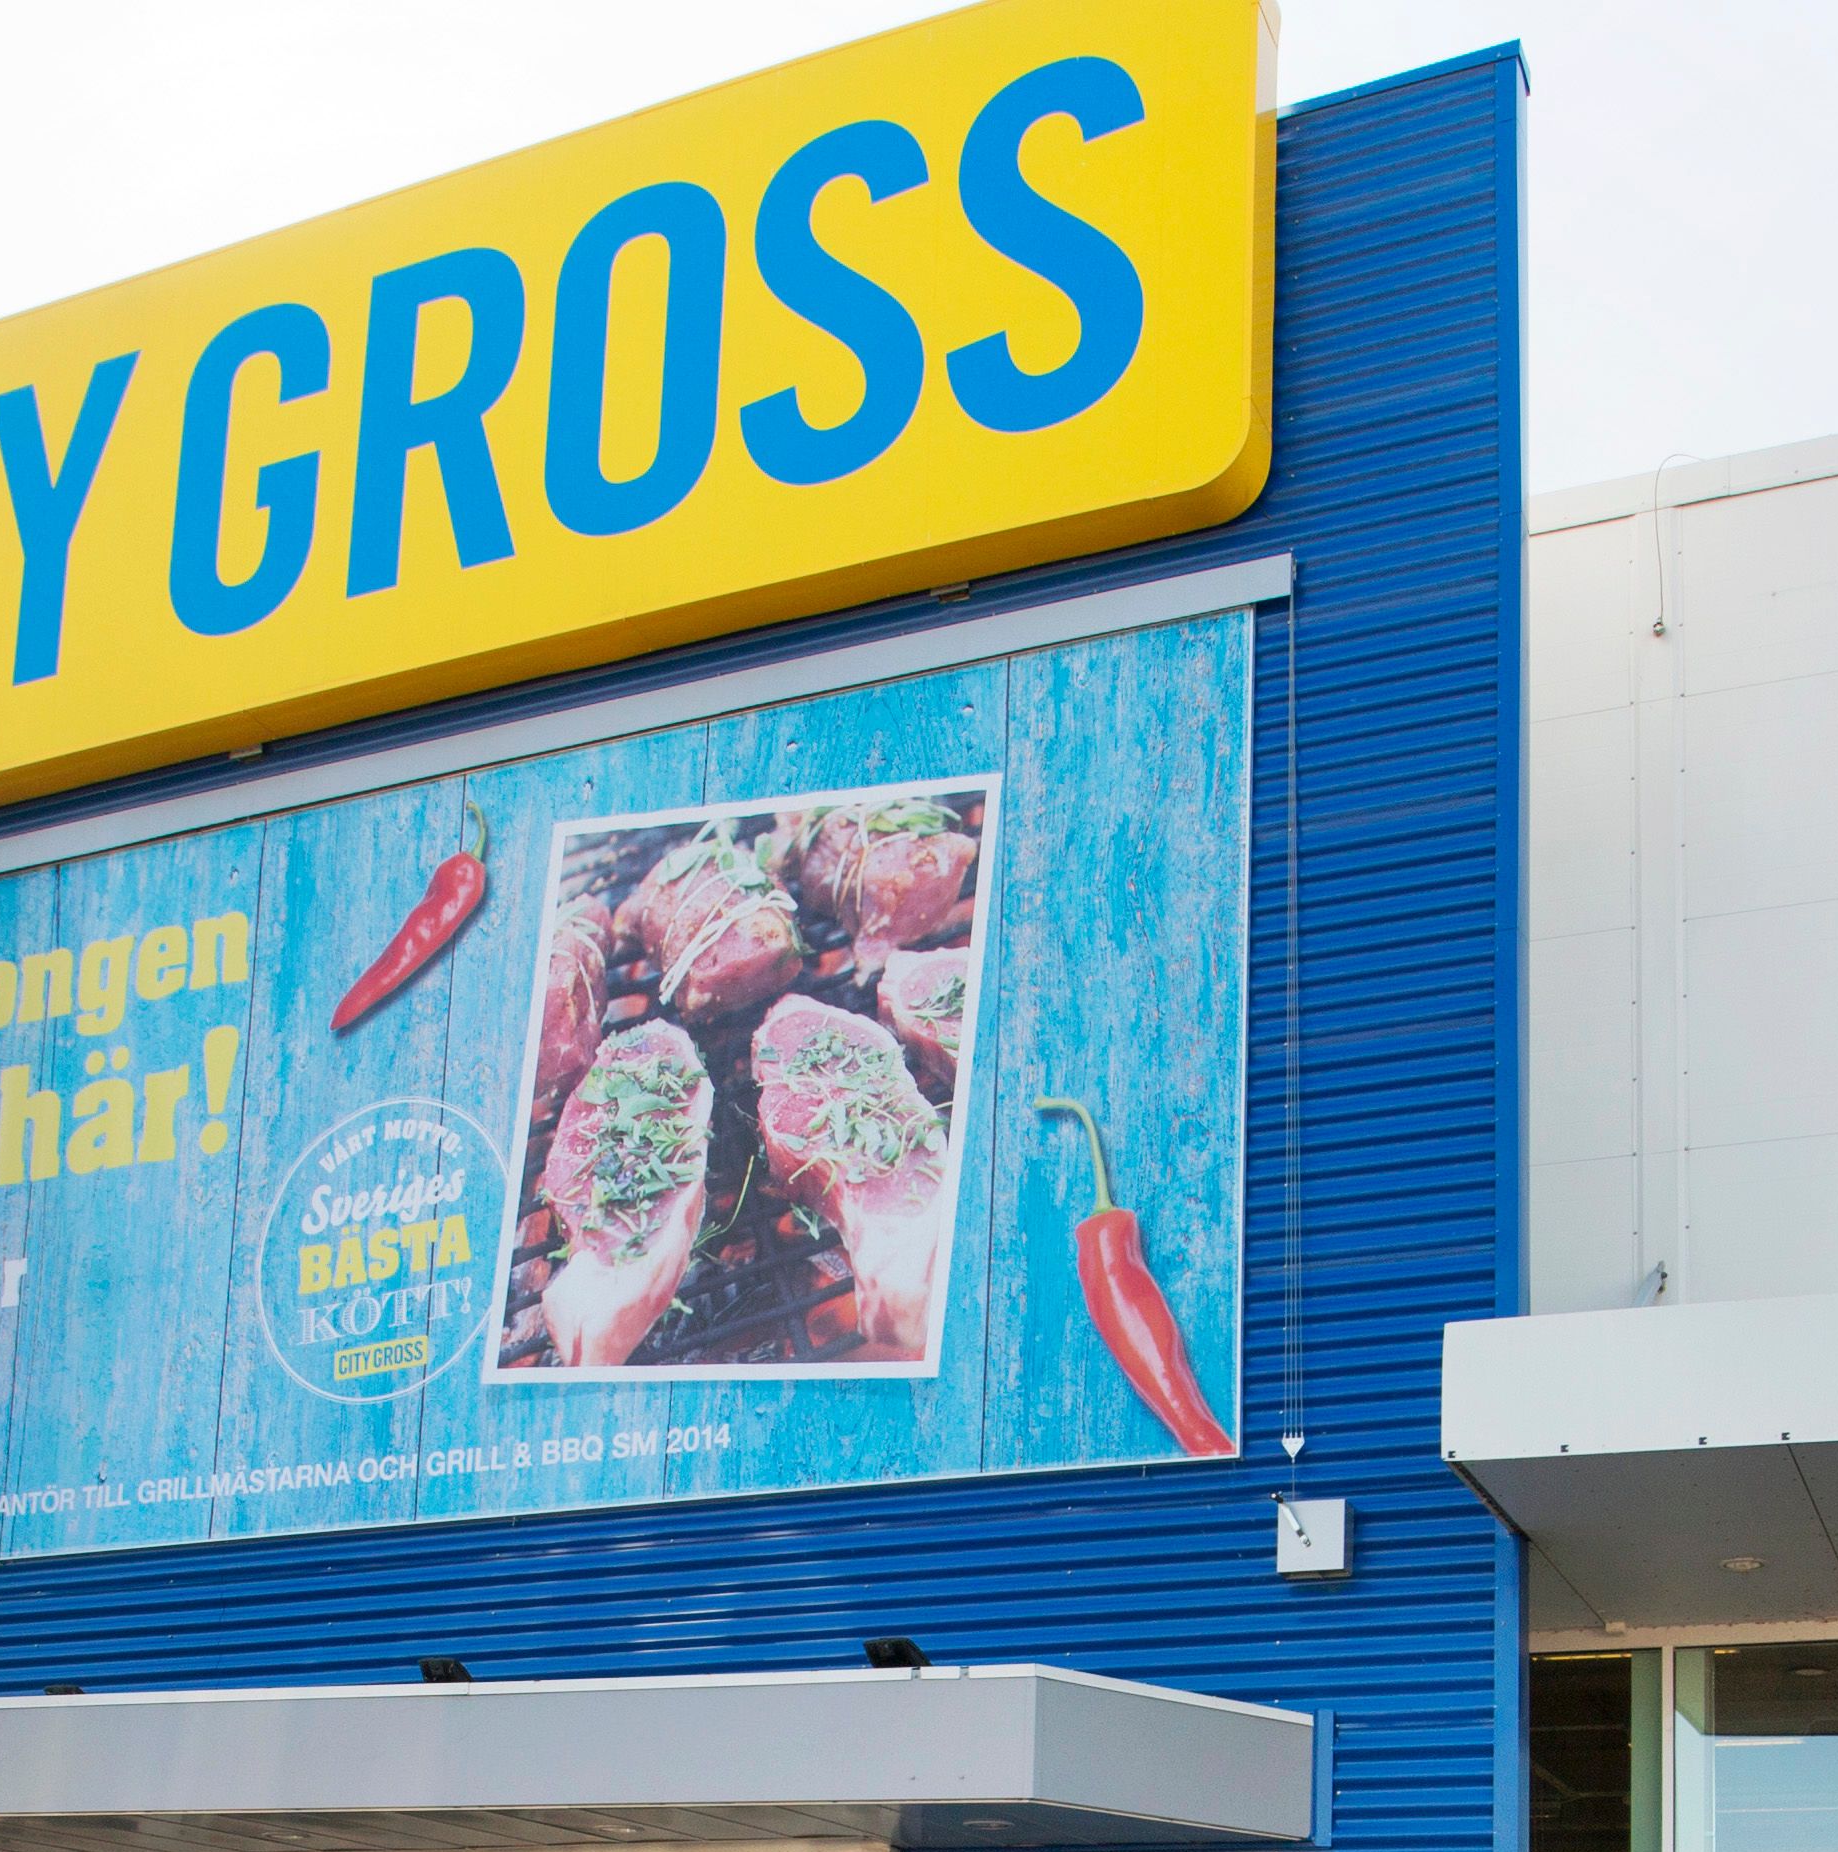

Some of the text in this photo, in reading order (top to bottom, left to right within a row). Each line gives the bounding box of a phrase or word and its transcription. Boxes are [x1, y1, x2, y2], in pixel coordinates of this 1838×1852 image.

[169, 56, 1147, 637] GROSS
[319, 1125, 376, 1174] VÅRT
[301, 1168, 466, 1235] Sveriges
[298, 1214, 472, 1295] BÄSTA
[297, 1277, 472, 1346] KÖTT!
[338, 1341, 424, 1376] CITY GROSS
[83, 1485, 131, 1510] TILL
[137, 1461, 350, 1505] GRILLMÄSTARNA
[358, 1454, 417, 1484] OCH
[426, 1447, 506, 1477] GRILL
[512, 1442, 533, 1468] &
[541, 1434, 603, 1466] BBQ
[611, 1430, 657, 1459] SM
[666, 1423, 731, 1454] 2014
